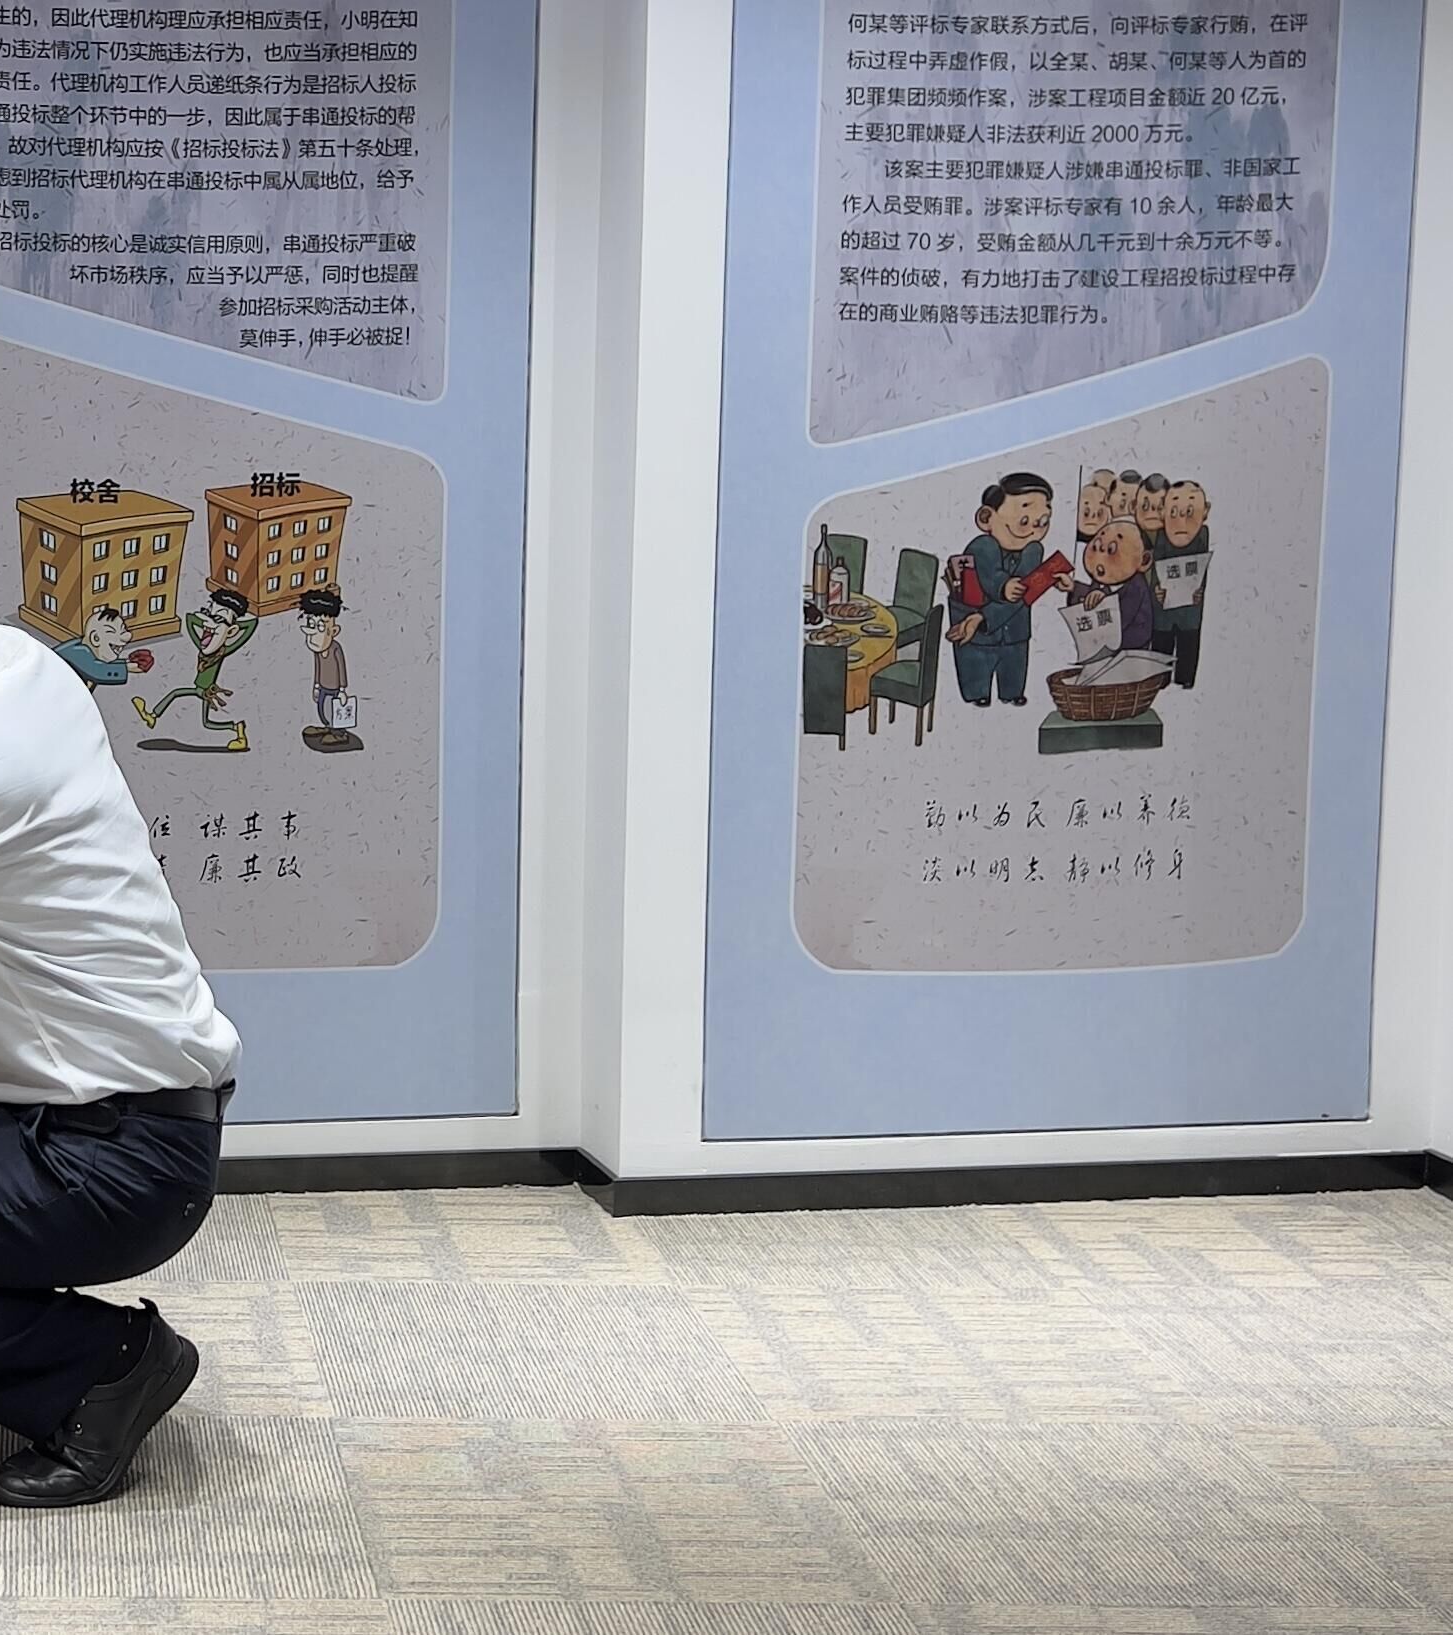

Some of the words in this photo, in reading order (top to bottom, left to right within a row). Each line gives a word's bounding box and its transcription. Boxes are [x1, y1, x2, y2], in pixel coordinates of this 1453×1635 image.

[218, 295, 417, 319] 参加招标采购活动主体，
[69, 478, 121, 504] 校舍
[250, 472, 302, 498] 招标
[1166, 560, 1199, 580] 选票
[1075, 607, 1114, 634] 选票
[200, 810, 300, 841] 谋其事
[198, 852, 301, 884] 廉其政
